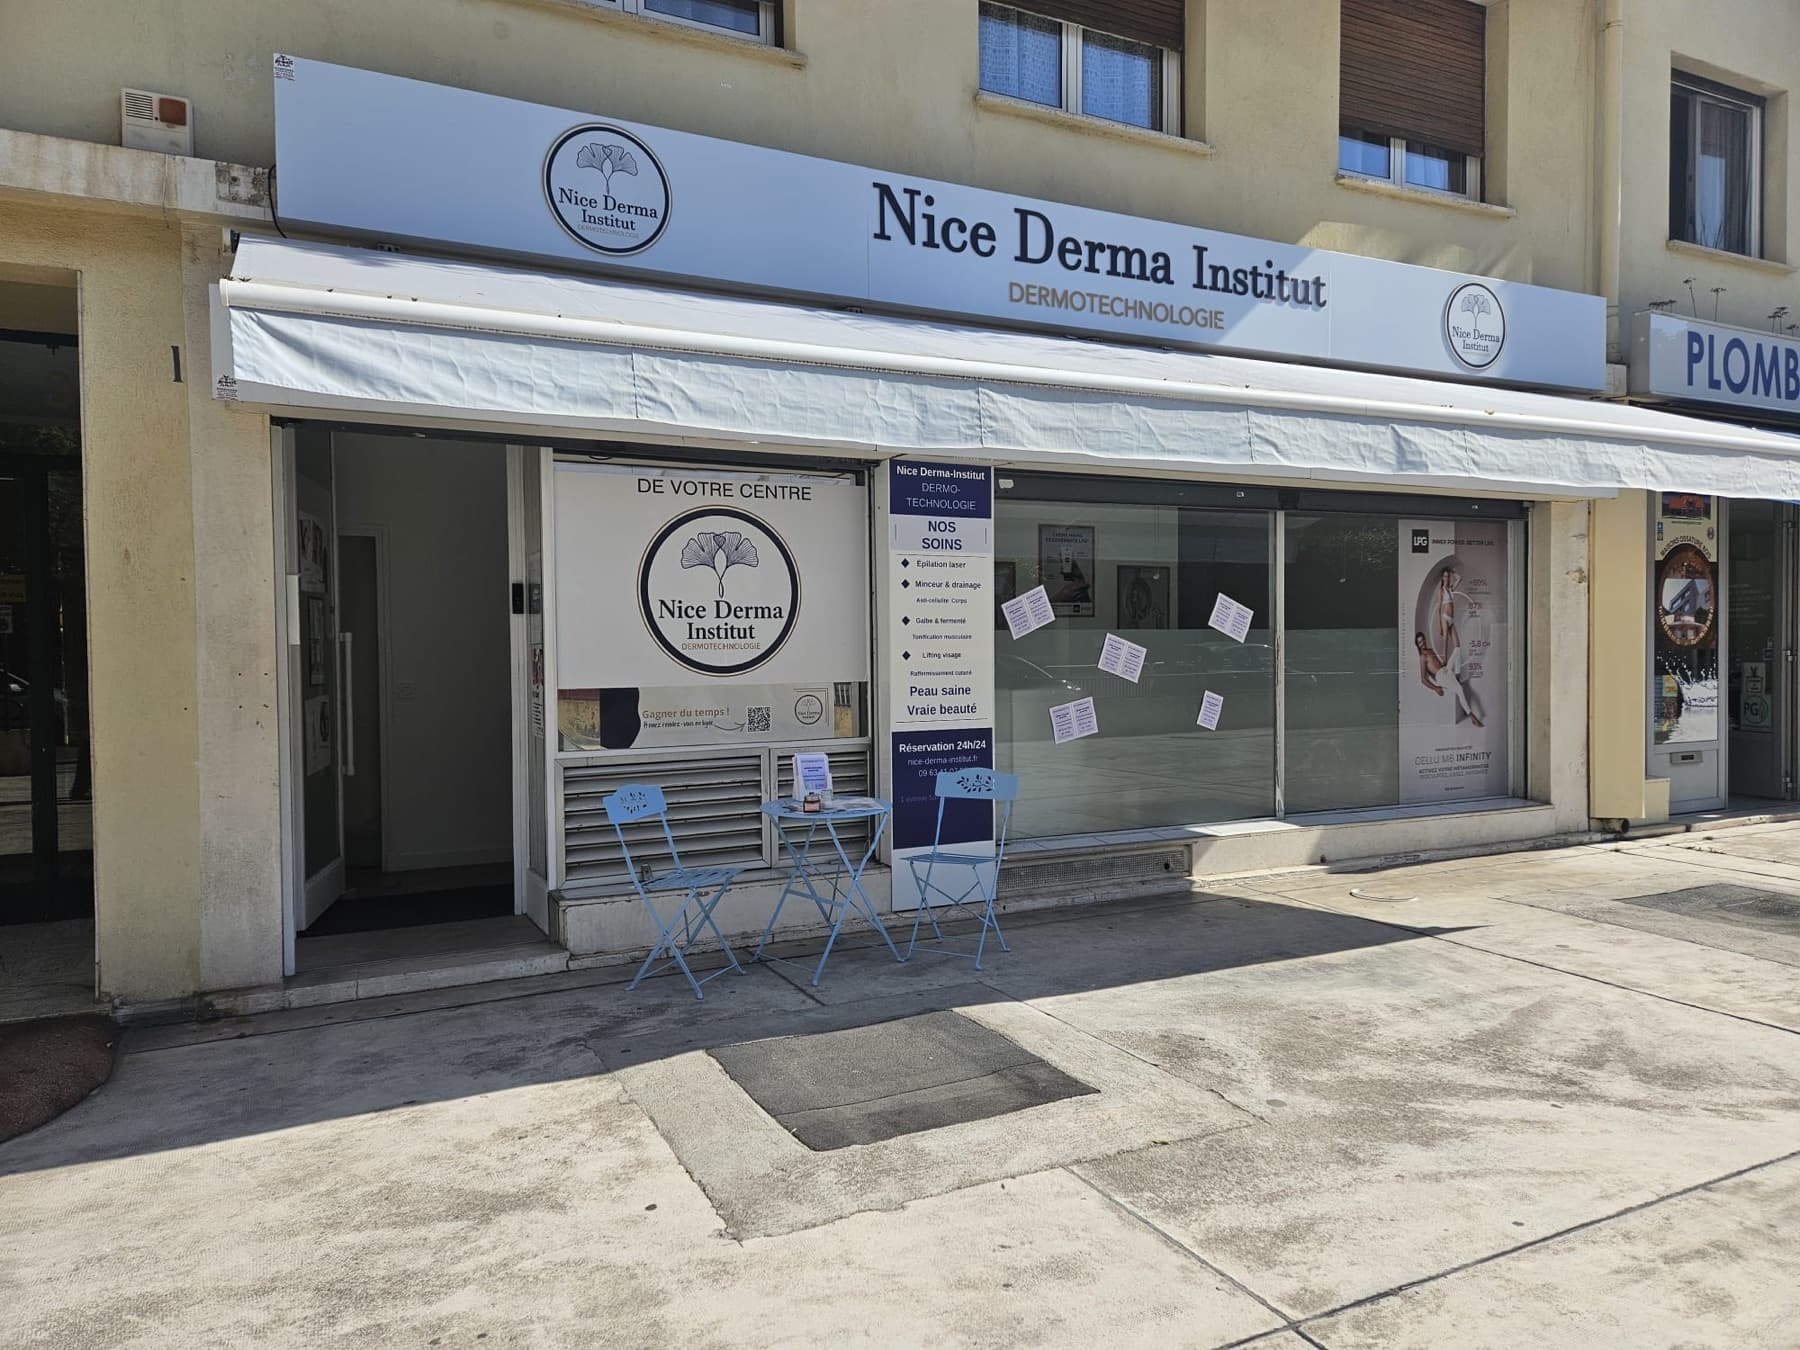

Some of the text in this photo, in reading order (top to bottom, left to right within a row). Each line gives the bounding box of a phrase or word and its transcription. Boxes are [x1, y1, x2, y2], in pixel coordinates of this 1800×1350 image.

[559, 186, 658, 219] Nice Derma
[581, 209, 636, 231] Institut
[872, 182, 1327, 310] Nice Derma Institut
[1008, 281, 1225, 330] DERMOTECHNOLOGIE
[1452, 326, 1500, 343] Nice Derma
[1462, 340, 1489, 353] Institut
[1687, 330, 1800, 401] PLOMB
[896, 465, 985, 481] Nice Derma-Institut
[637, 478, 812, 501] DE VOTRE CENTRE
[922, 482, 961, 494] DERMO-
[906, 497, 977, 510] TECHNOLOGIE
[928, 520, 957, 533] NOS
[922, 537, 962, 550] SOINS
[1413, 536, 1428, 546] LPG
[949, 561, 966, 569] laser
[915, 580, 943, 588] Minceur
[952, 581, 982, 591] drainage
[658, 599, 784, 620] Nice Derma
[687, 622, 756, 641] Institut
[681, 641, 761, 651] DERMOTECHNOLOGIE
[910, 684, 971, 697] Peau saine
[642, 710, 678, 721] Gagner
[680, 708, 692, 717] du
[695, 708, 725, 718] temps
[907, 702, 977, 715] Vraie beauté
[900, 740, 986, 752] Réservation 24h/24
[907, 755, 978, 766] nice-derma-institut.fr
[1456, 752, 1492, 762] INFINITY
